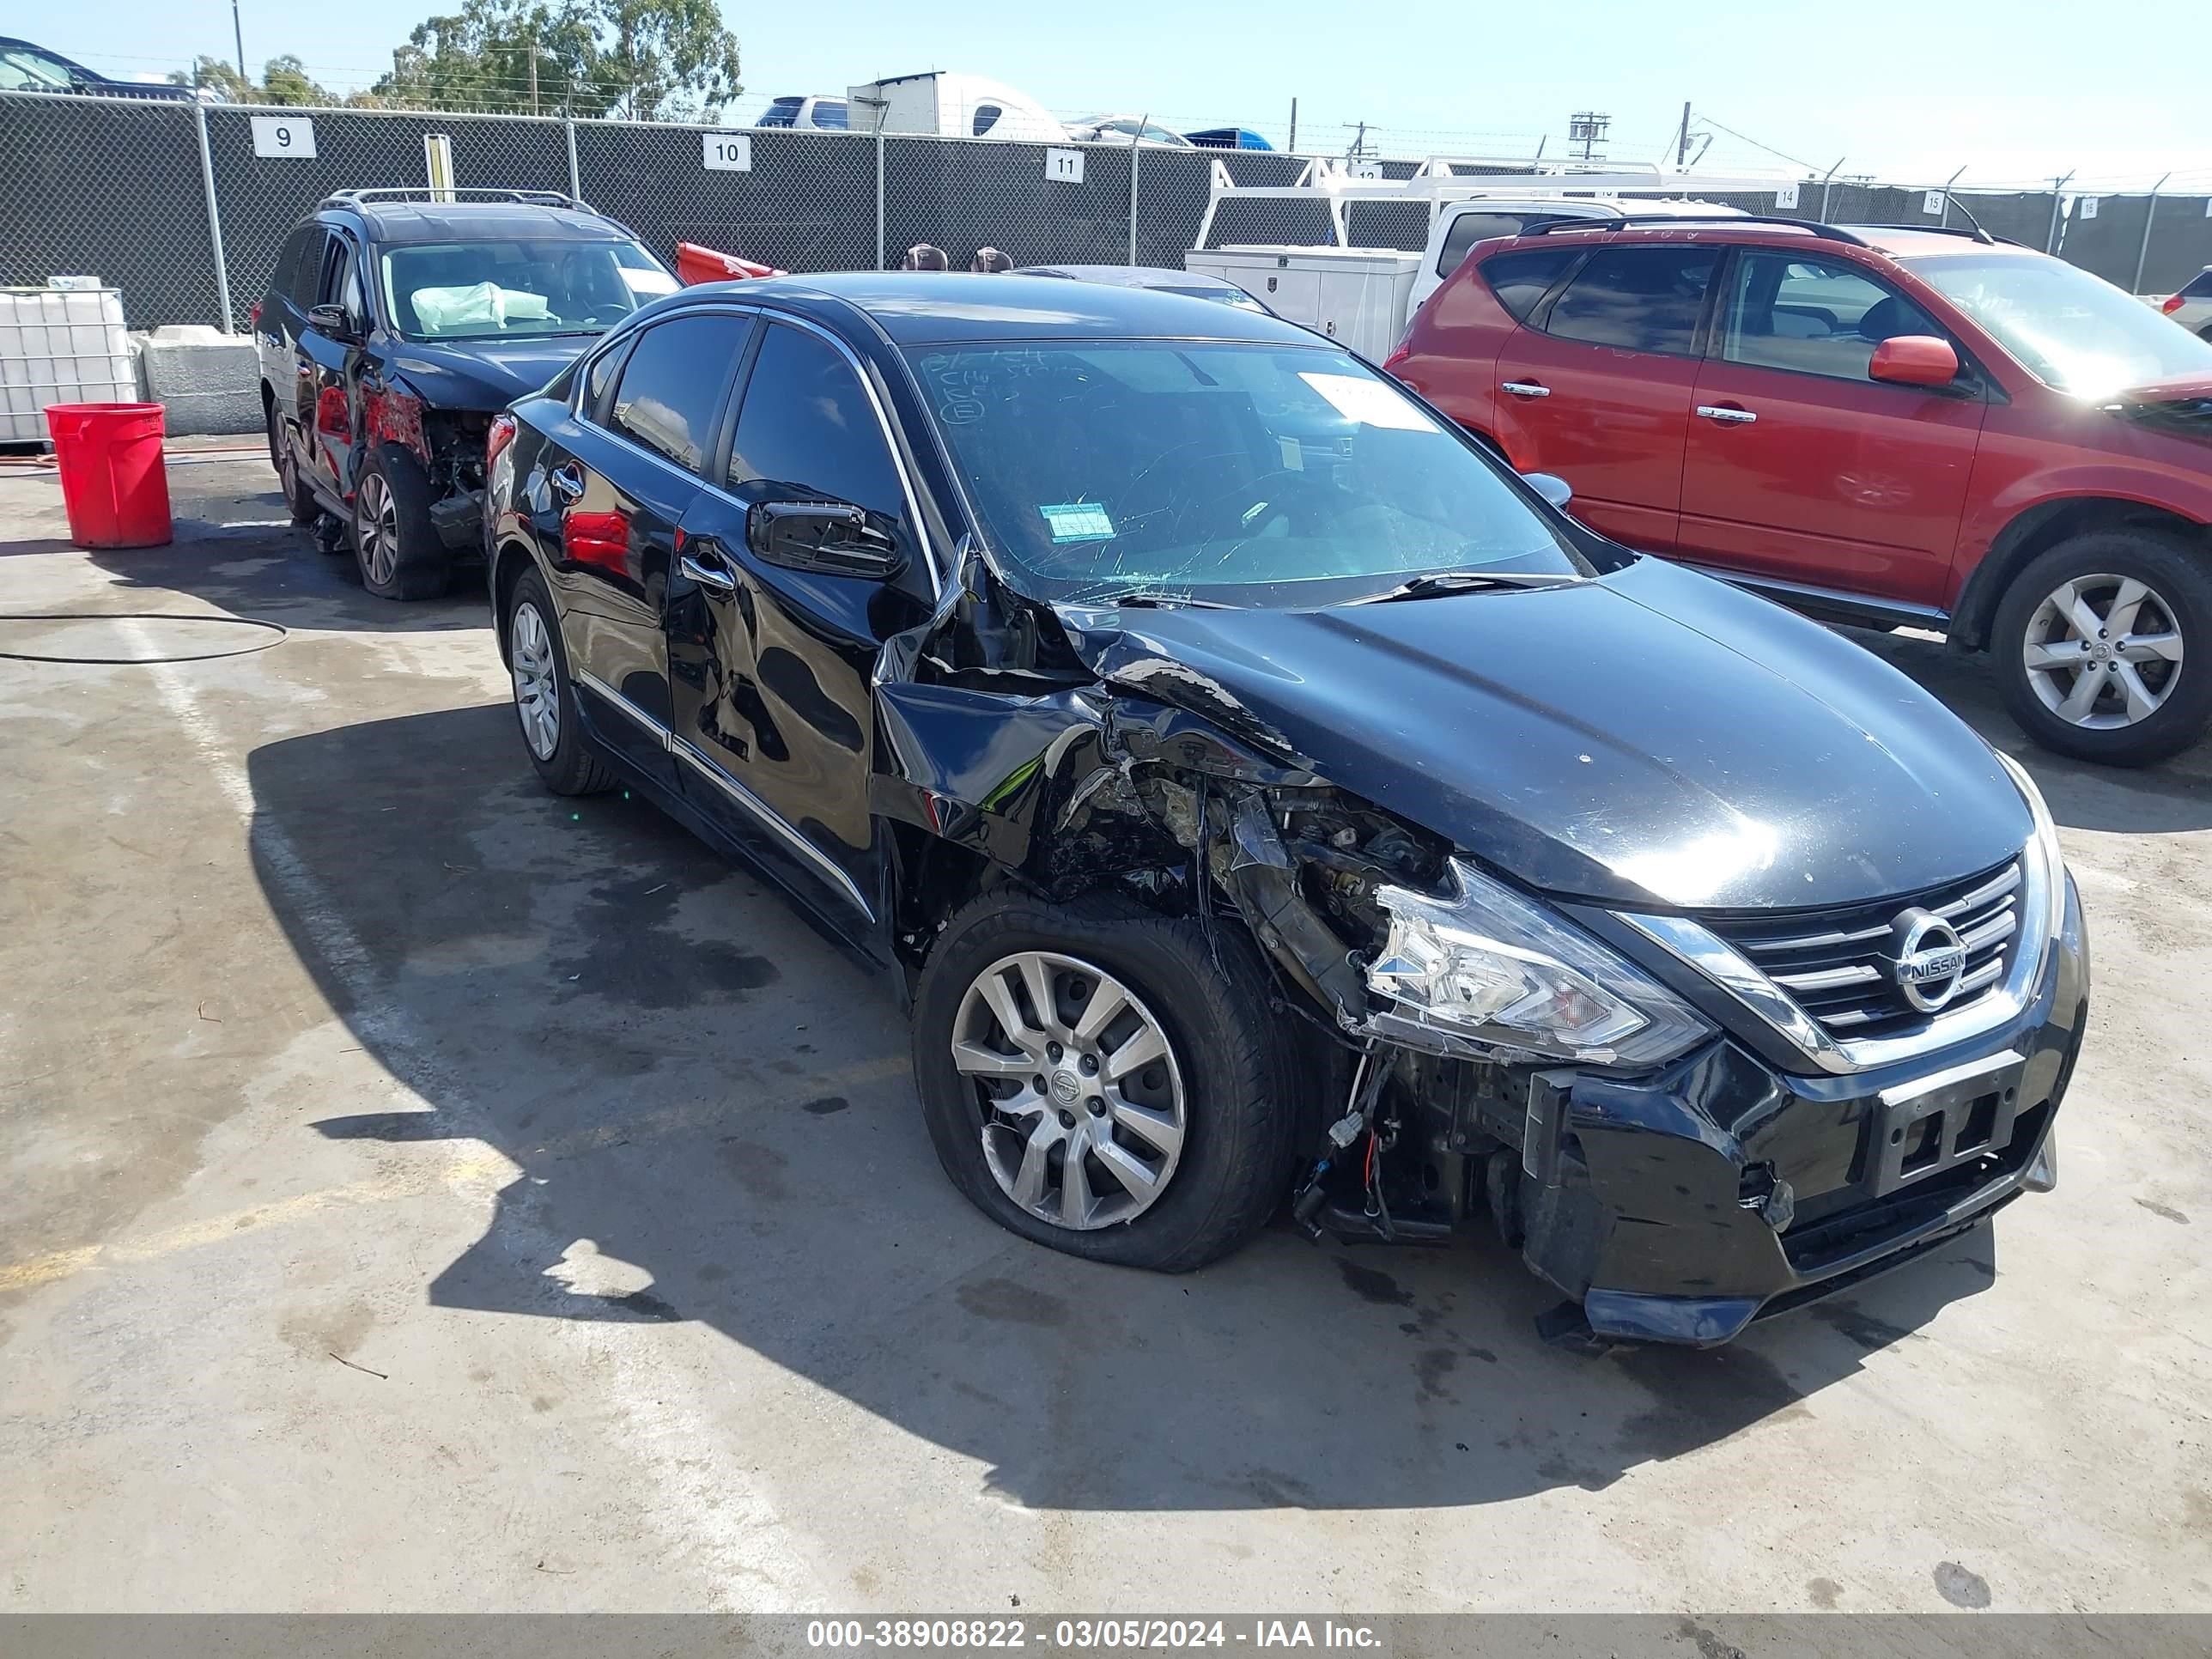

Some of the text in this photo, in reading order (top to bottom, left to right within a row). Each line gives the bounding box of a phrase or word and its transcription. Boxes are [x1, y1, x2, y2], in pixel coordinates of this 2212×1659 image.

[276, 127, 291, 148] 9
[715, 143, 738, 162] 10
[1057, 157, 1073, 174] 11
[1783, 191, 1793, 204] 14
[1929, 197, 1939, 209] 15
[1911, 954, 1965, 979] NISSAN
